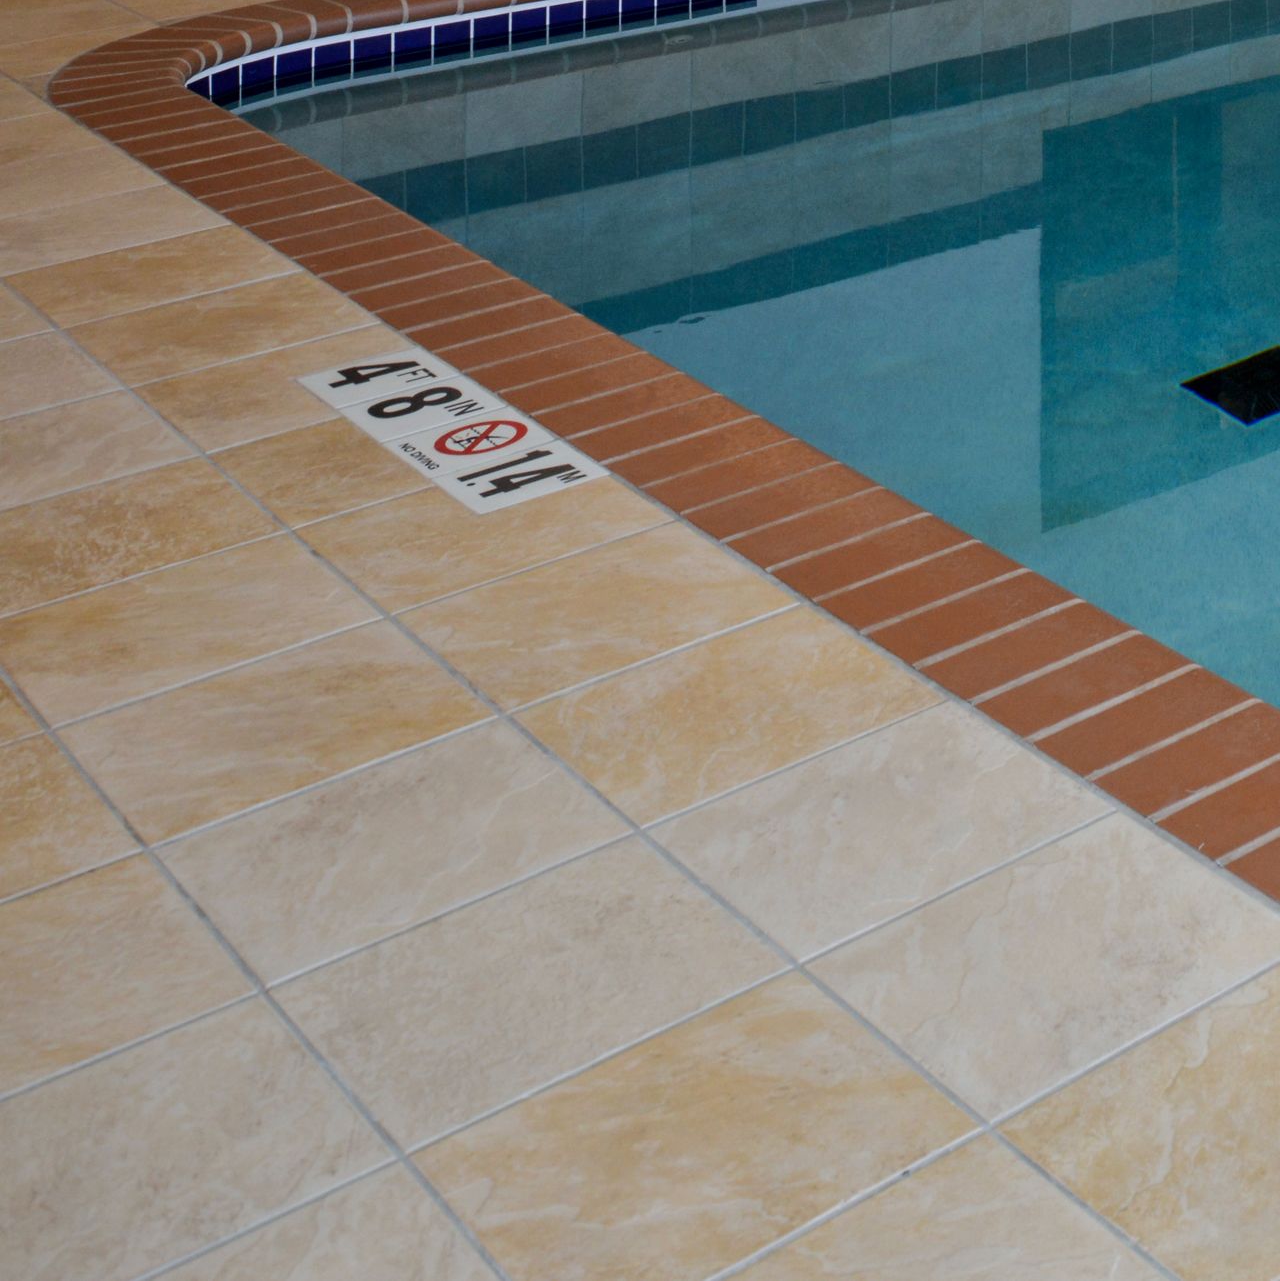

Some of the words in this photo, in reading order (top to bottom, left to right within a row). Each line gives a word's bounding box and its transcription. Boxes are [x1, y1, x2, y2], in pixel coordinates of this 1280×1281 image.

[328, 360, 420, 389] 4
[396, 367, 437, 383] FT
[367, 386, 463, 419] 8
[444, 399, 484, 417] IN
[398, 441, 416, 454] NO
[411, 448, 440, 471] DIVING
